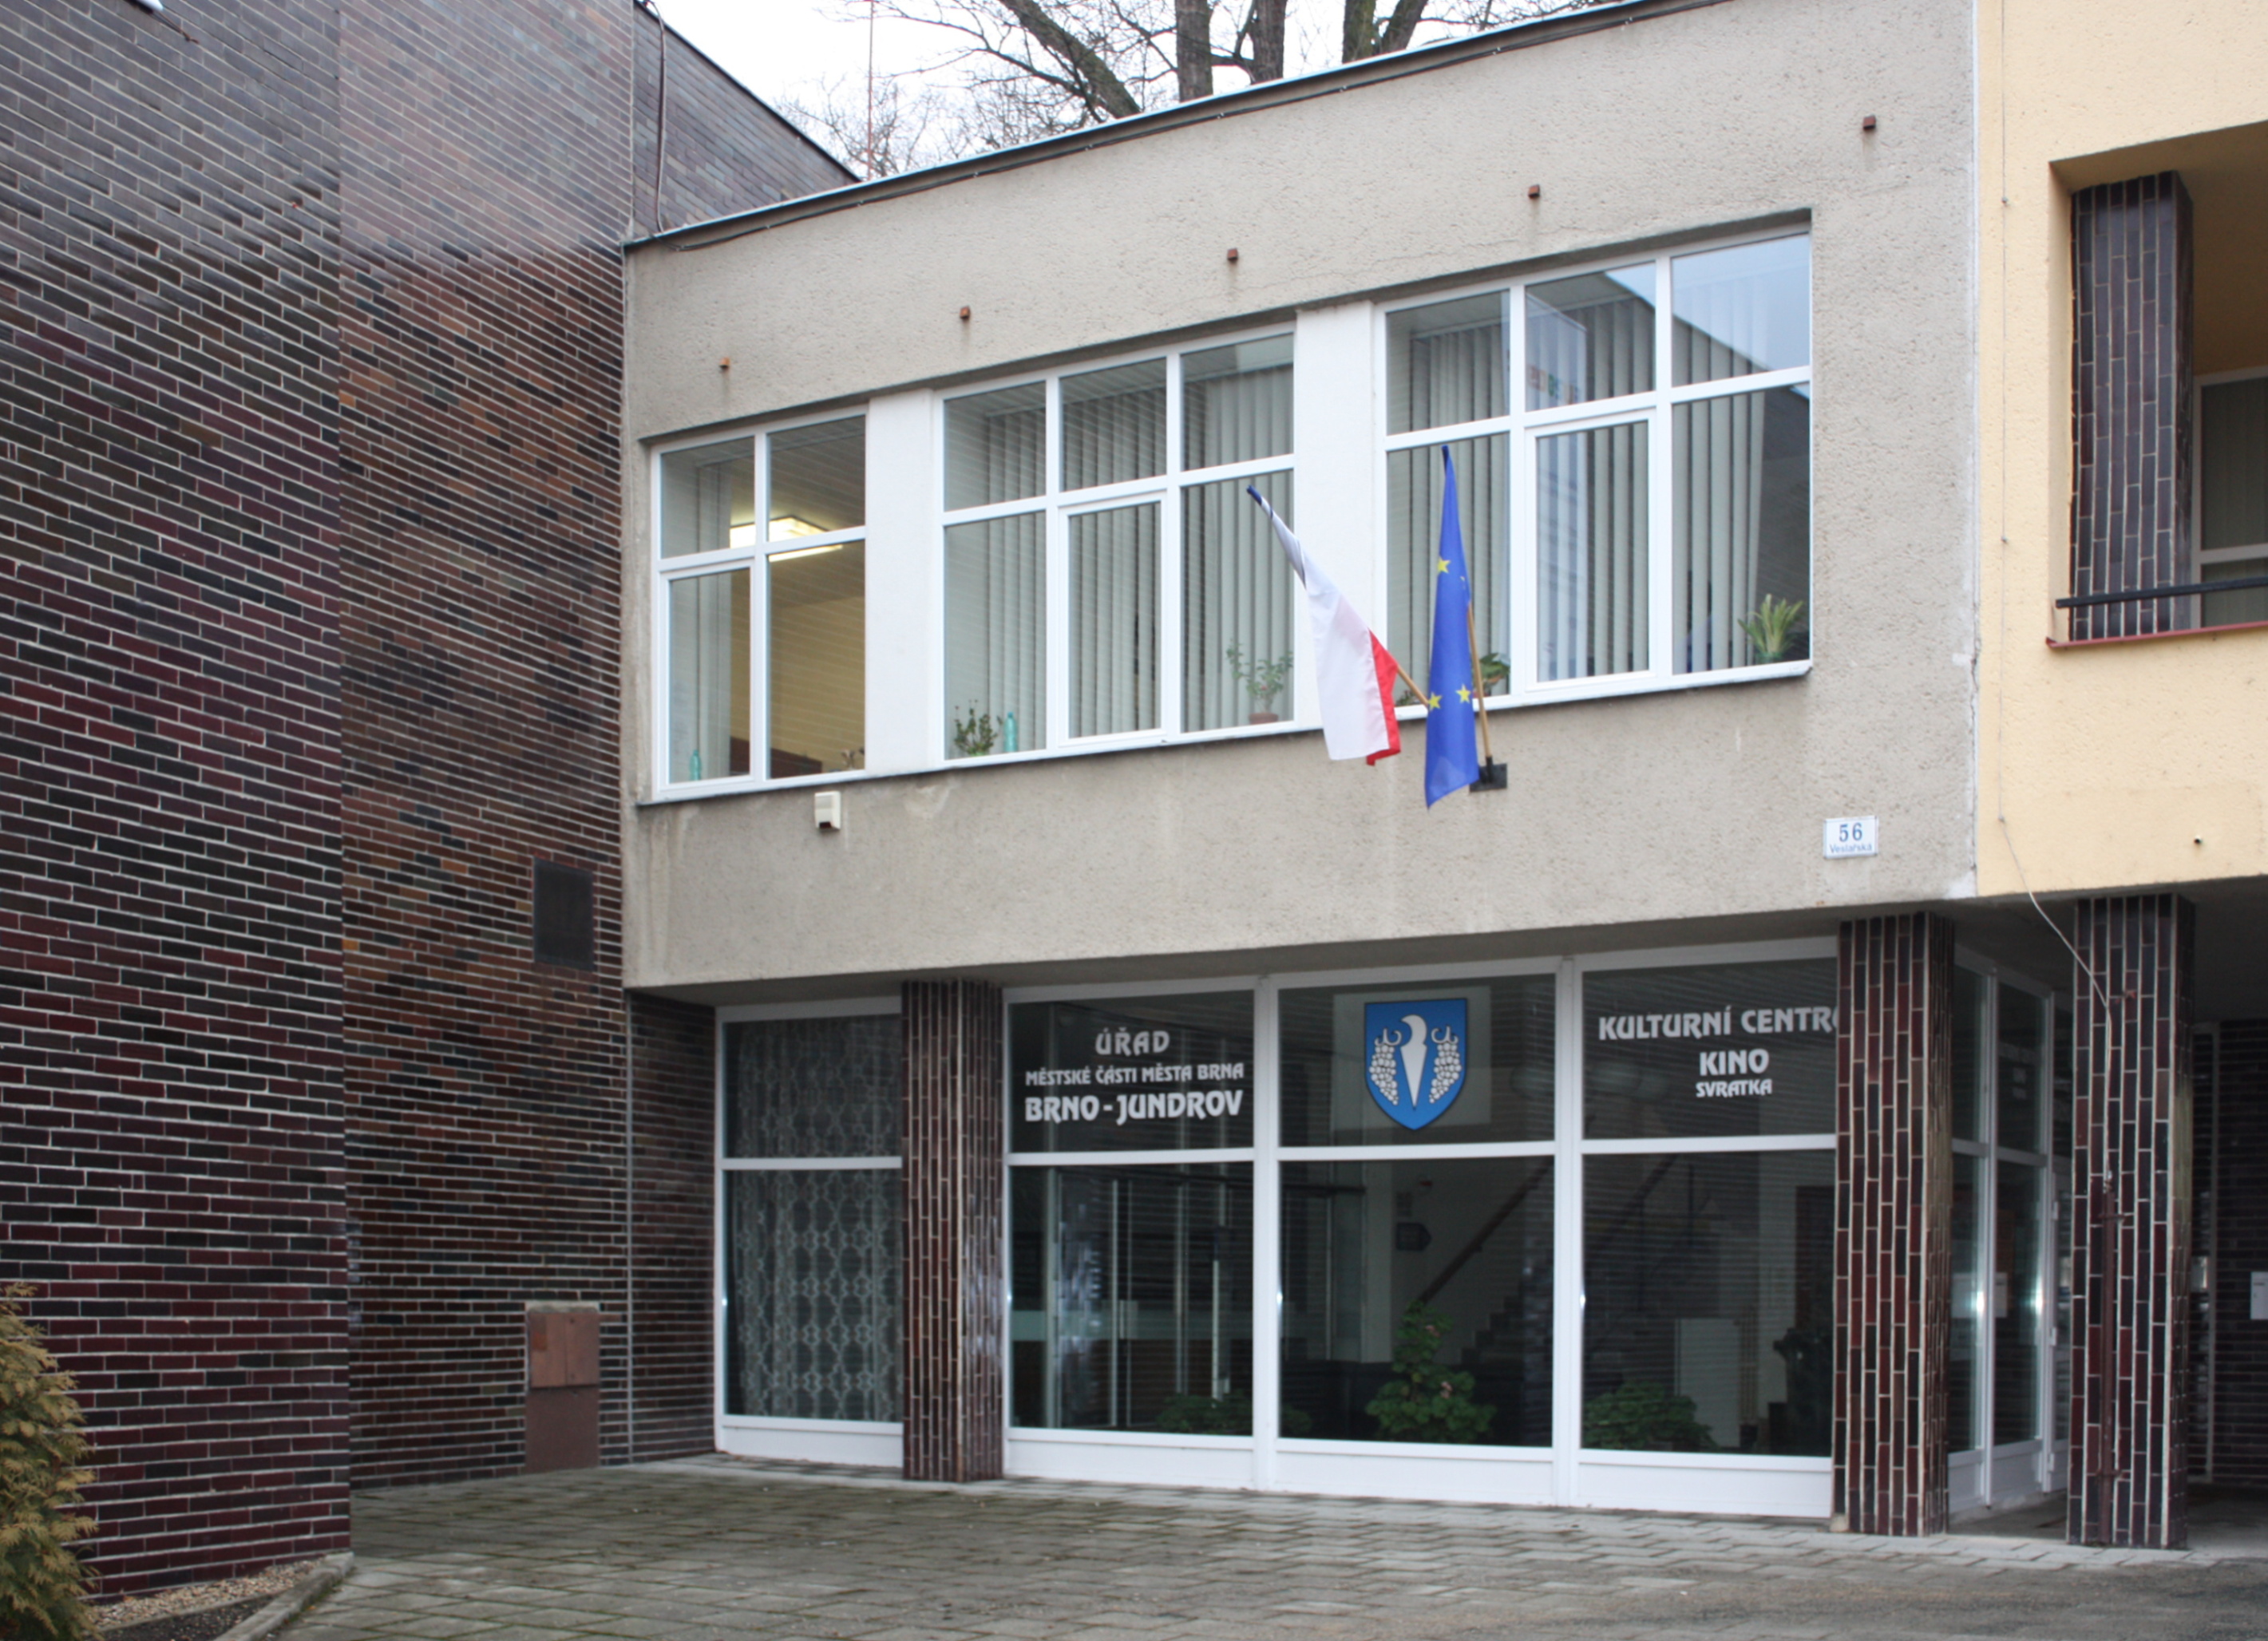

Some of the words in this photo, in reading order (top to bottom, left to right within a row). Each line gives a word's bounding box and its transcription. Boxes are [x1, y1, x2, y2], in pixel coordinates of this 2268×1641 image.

[1839, 822, 1862, 842] 56
[1599, 1005, 1732, 1040] KULTURNÍ
[1741, 1006, 1838, 1034] CENTR
[1095, 1026, 1170, 1057] ÚŘAD
[1025, 1066, 1091, 1086] MĚSTSKÉ
[1094, 1065, 1138, 1085] ČÁSTI
[1142, 1062, 1193, 1083] MĚSTA
[1197, 1062, 1244, 1081] BRNA
[1700, 1049, 1770, 1076] KINO
[1696, 1078, 1773, 1098] SVRATKA
